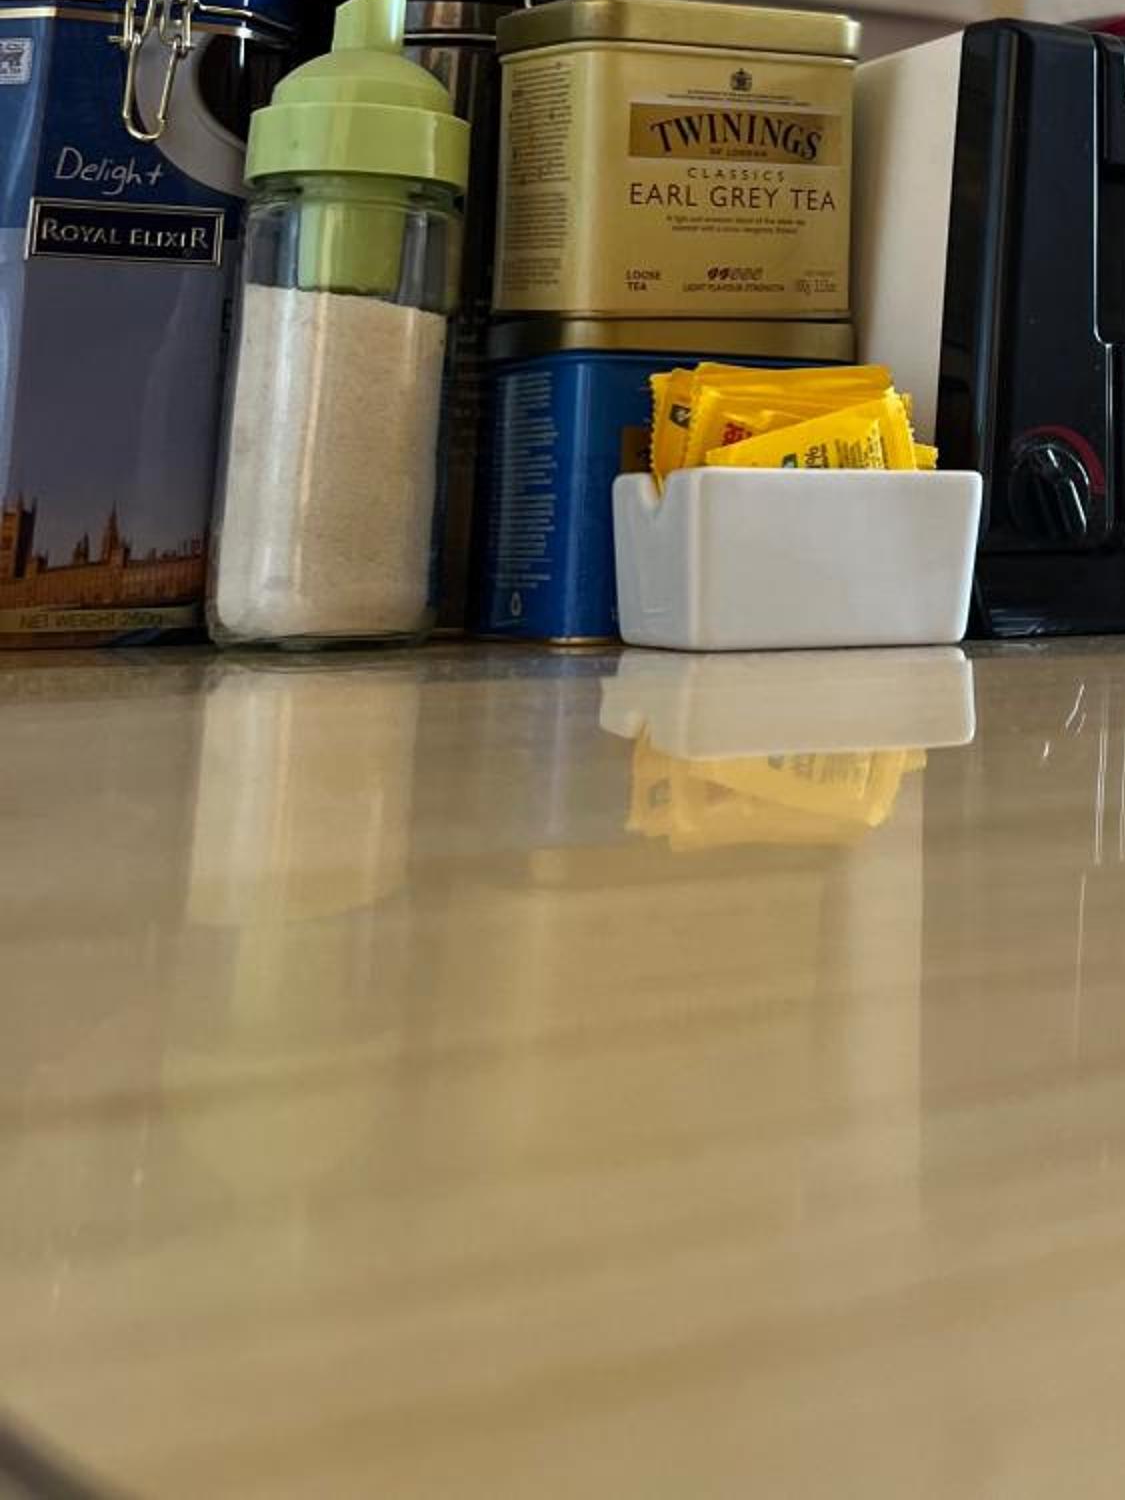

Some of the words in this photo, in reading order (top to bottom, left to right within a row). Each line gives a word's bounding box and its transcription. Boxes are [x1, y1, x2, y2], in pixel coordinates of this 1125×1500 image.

[650, 112, 822, 160] TWININGS
[54, 146, 163, 195] Delight
[687, 167, 785, 181] CLASSICS
[630, 183, 698, 206] EARL
[710, 186, 779, 208] GREY
[790, 188, 835, 211] TEA
[41, 218, 121, 245] ROYAL
[129, 227, 208, 249] ELIXIR
[626, 269, 661, 281] LOOSE
[627, 282, 647, 292] TEA
